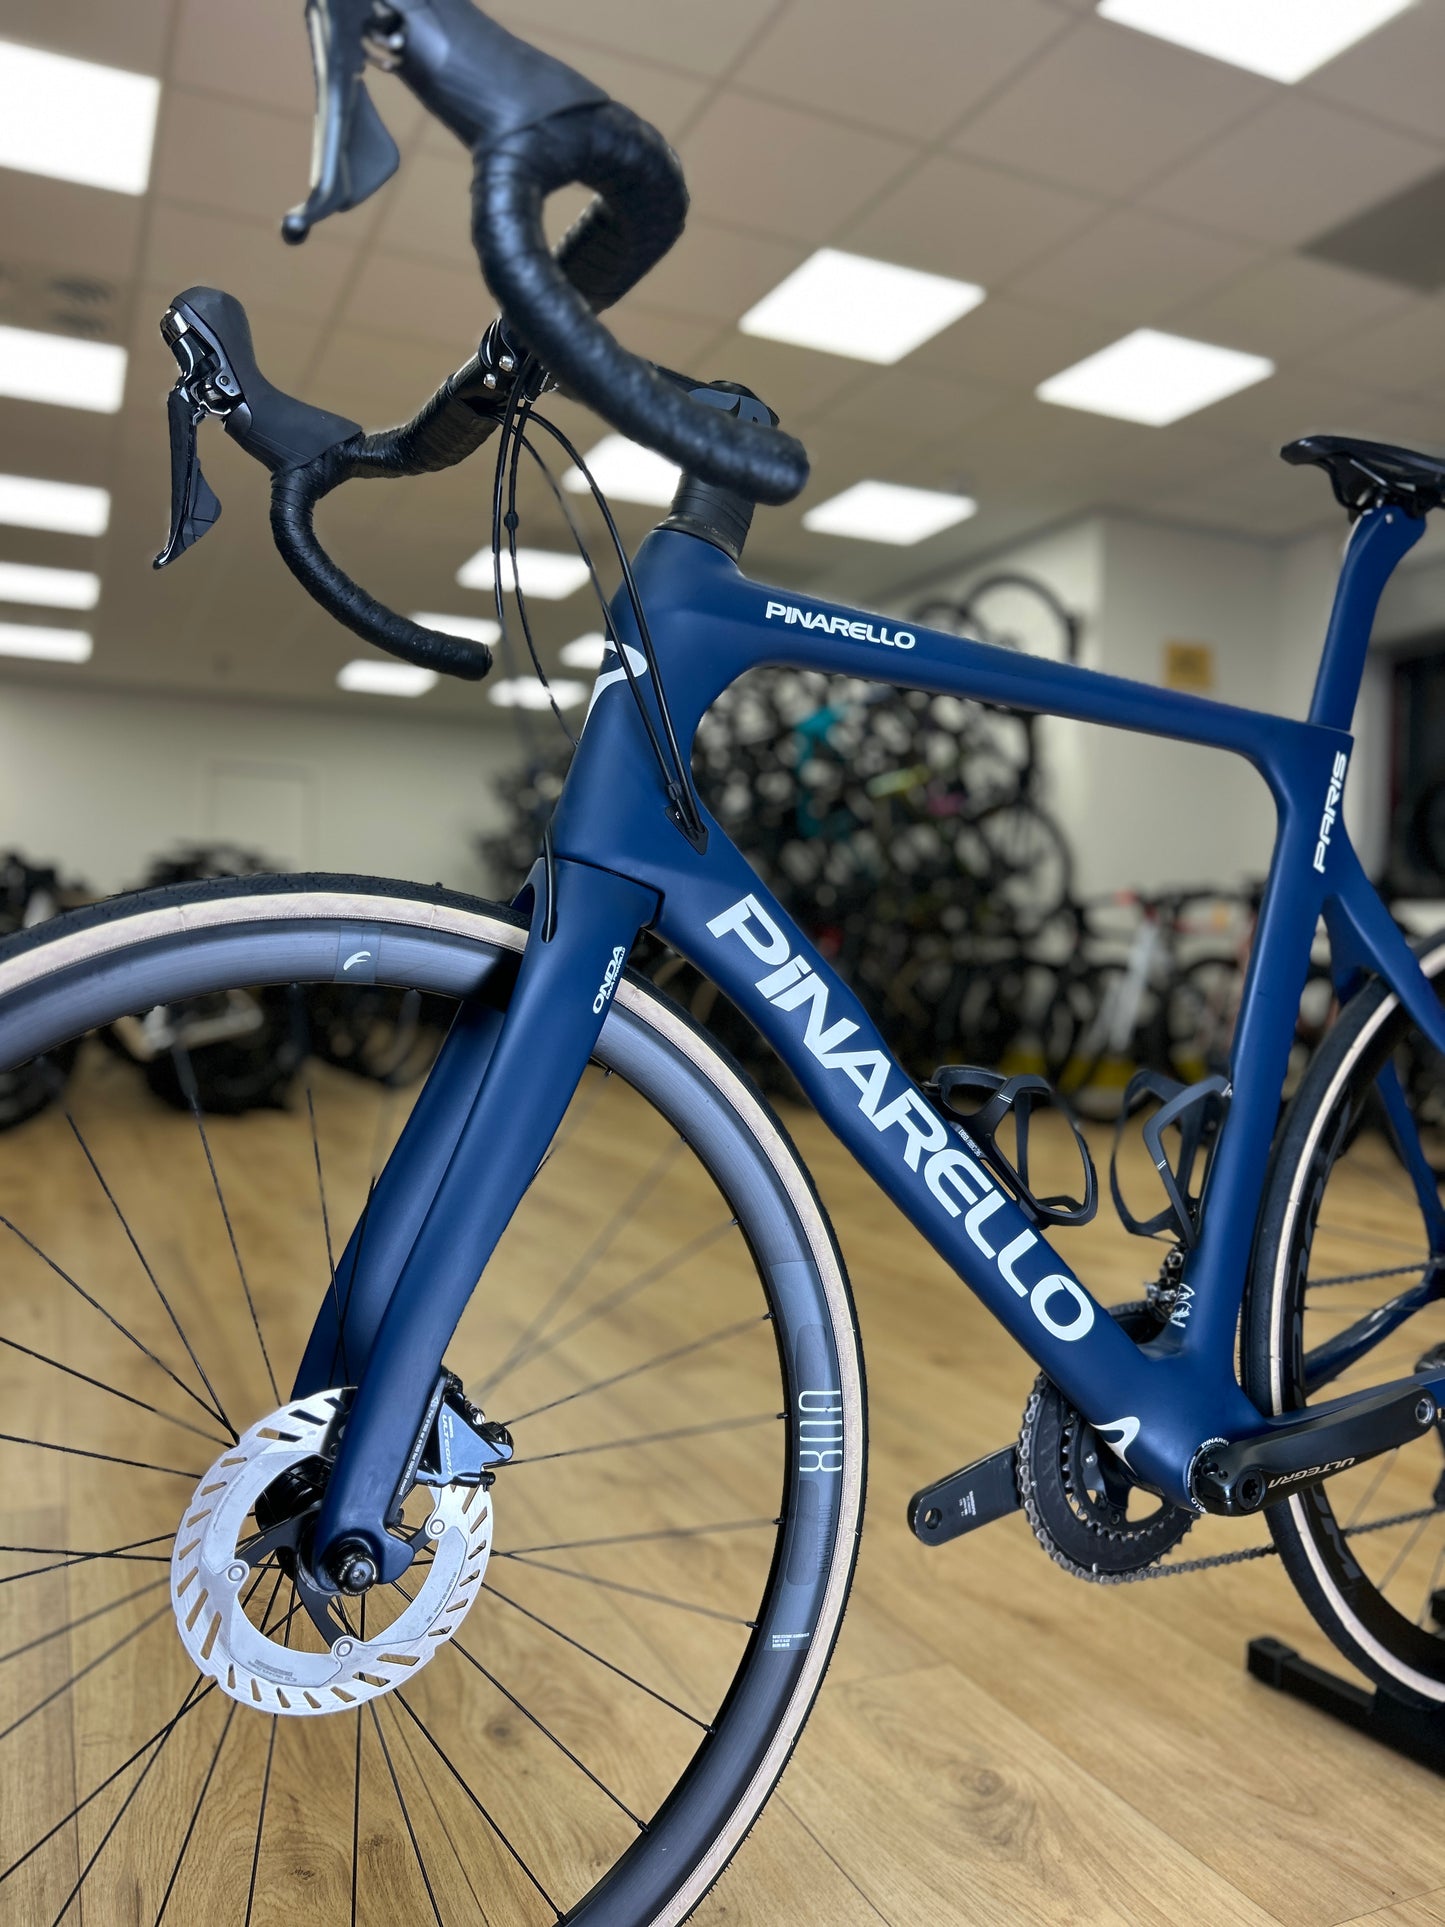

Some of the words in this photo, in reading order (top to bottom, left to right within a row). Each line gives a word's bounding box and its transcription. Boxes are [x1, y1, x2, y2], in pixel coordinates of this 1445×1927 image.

[765, 600, 917, 650] PINARELLO
[1312, 749, 1348, 875] PARIS
[592, 945, 624, 1015] ONDA
[705, 892, 1096, 1343] PINARELLO
[441, 1413, 453, 1476] ULTEGRA
[1267, 1457, 1356, 1489] ULTEGRA
